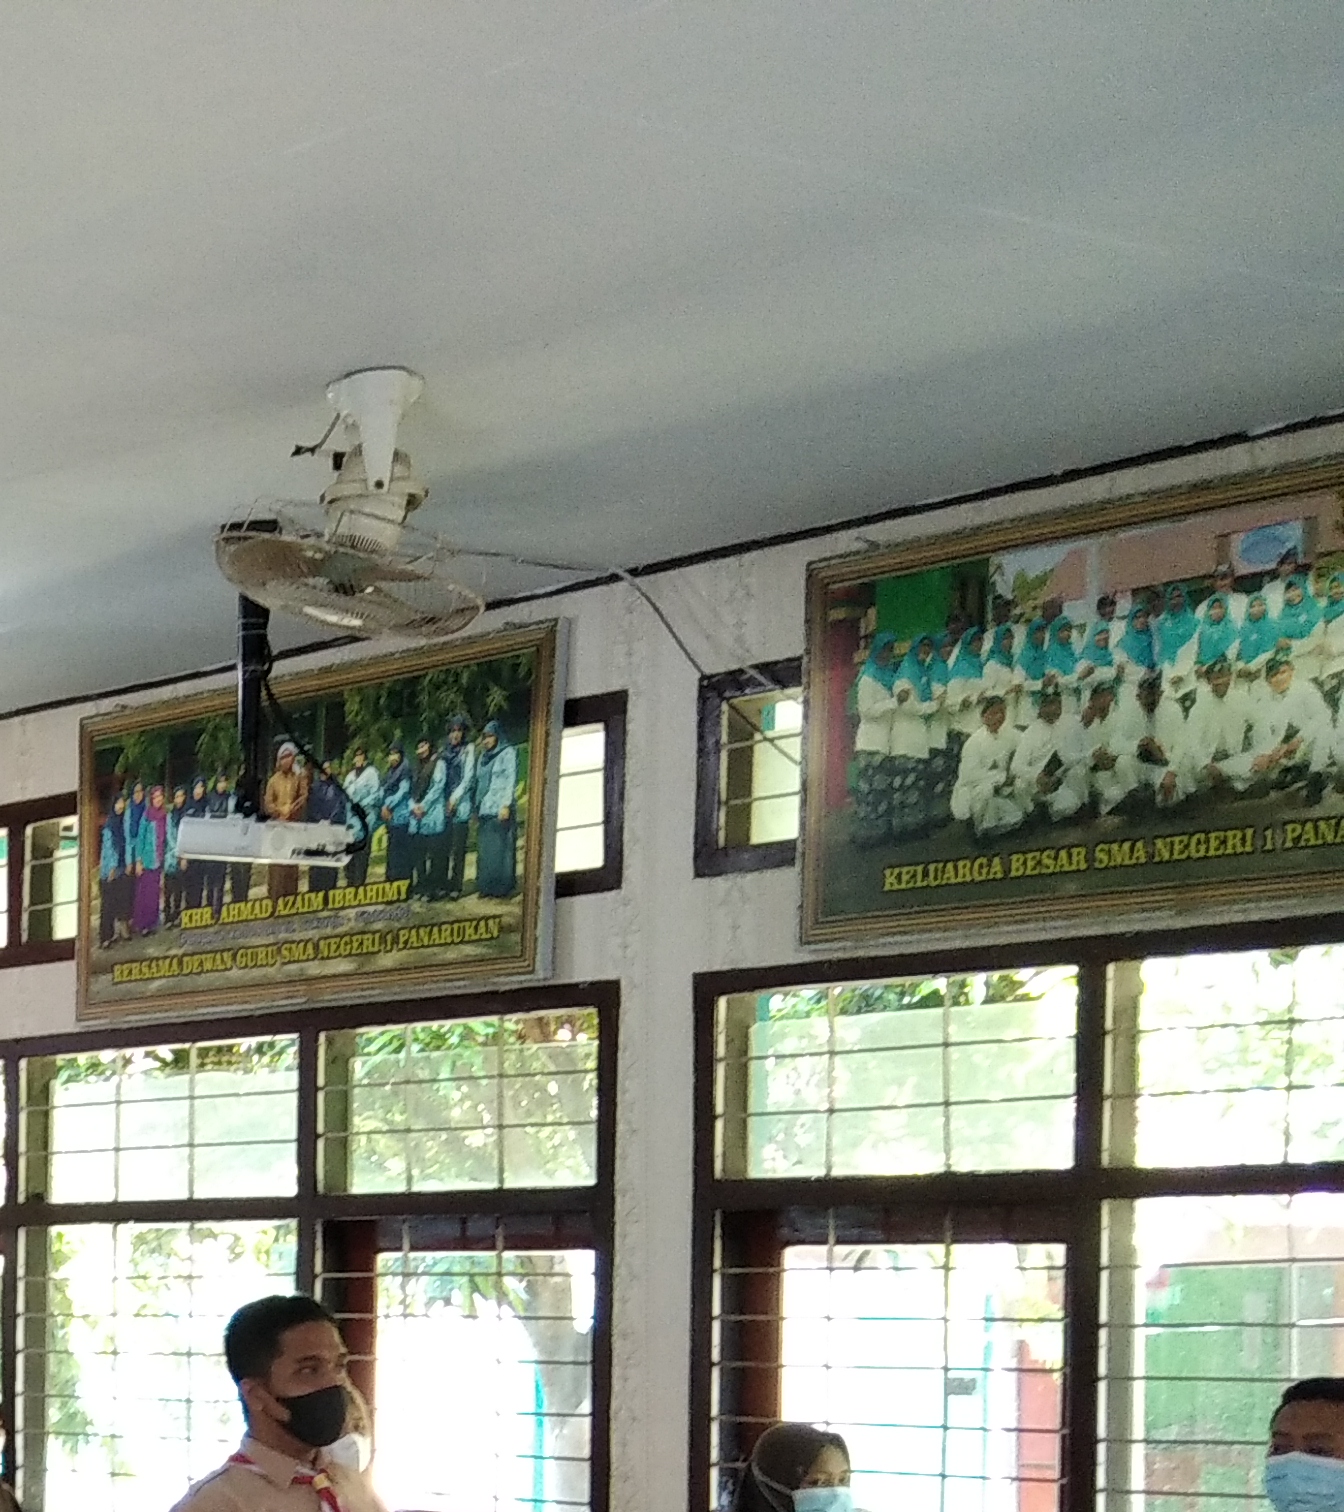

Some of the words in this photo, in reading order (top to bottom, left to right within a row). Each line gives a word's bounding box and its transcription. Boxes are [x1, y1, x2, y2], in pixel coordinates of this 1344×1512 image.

[882, 855, 1005, 892] KELUARGA
[1009, 846, 1089, 878] BESAR
[1093, 838, 1148, 870] SMA
[1152, 826, 1256, 863] NEGERI
[1263, 827, 1275, 851] 1
[219, 898, 274, 923] AHMAD
[274, 889, 326, 917] AZAIM
[328, 879, 411, 909] IBRAHIMY
[113, 957, 180, 983] BERSAMA
[181, 950, 235, 975] DEWAN
[235, 944, 278, 968] GURU
[280, 939, 315, 962] SMA
[318, 931, 381, 959] NEGERI
[396, 916, 502, 950] PANARUKAN
